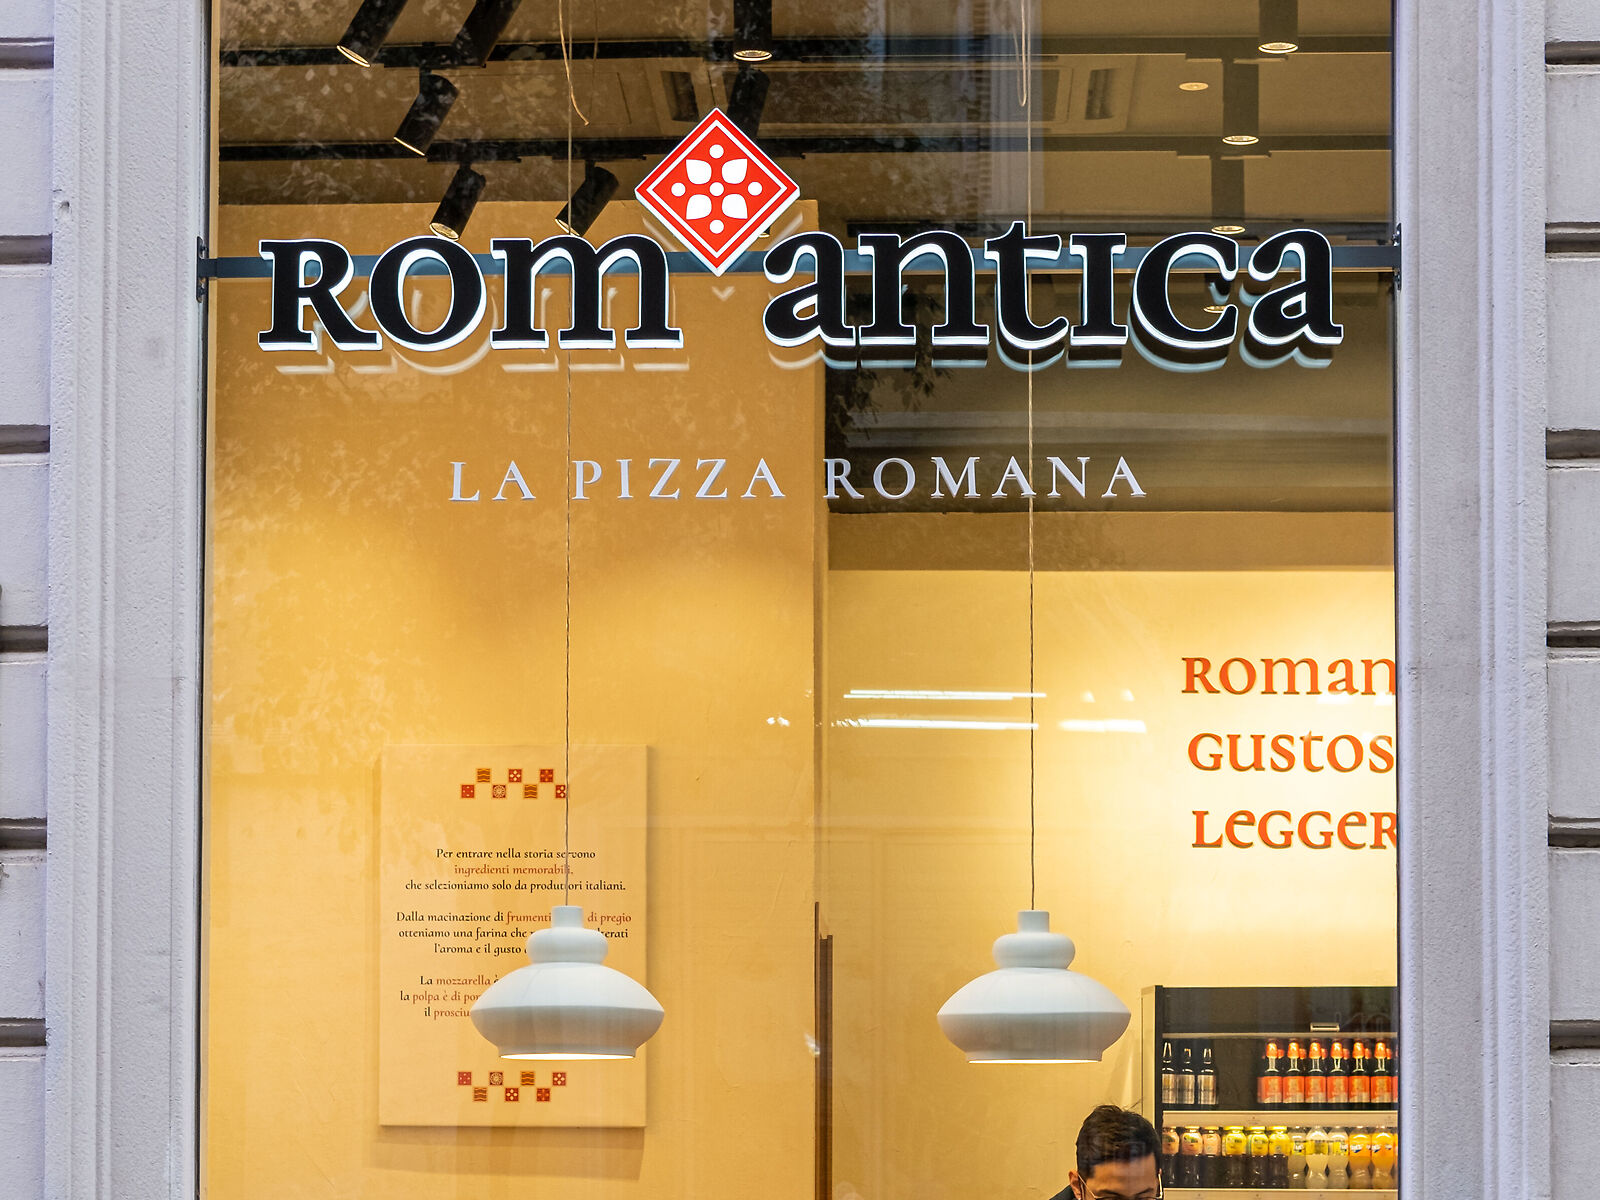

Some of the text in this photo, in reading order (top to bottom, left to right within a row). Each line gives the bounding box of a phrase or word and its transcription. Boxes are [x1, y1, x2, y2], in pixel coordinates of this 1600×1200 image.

[449, 455, 1148, 502] LA PIZZA ROMANA
[436, 848, 453, 858] Per
[456, 850, 493, 859] entrare
[496, 848, 521, 859] nella
[524, 848, 554, 859] storia
[454, 864, 510, 878] ingredienti
[405, 880, 626, 893] che selezioniamo solo da produtori italiani.
[396, 911, 425, 922] Dalla
[427, 912, 491, 922] macinazione
[493, 911, 504, 922] di
[587, 912, 598, 922] di
[600, 913, 632, 926] pregio
[398, 928, 451, 938] otteniamo
[453, 930, 473, 938] una
[475, 927, 508, 941] farina
[510, 928, 528, 938] che
[475, 946, 481, 954] e
[484, 943, 491, 954] il
[493, 946, 522, 958] gusto
[420, 976, 433, 985] La
[436, 975, 491, 985] mozzarella
[400, 990, 410, 1001] la
[412, 990, 440, 1004] polpa
[442, 990, 448, 1001] è
[450, 990, 461, 1001] di
[424, 1006, 470, 1020] il prosciu
